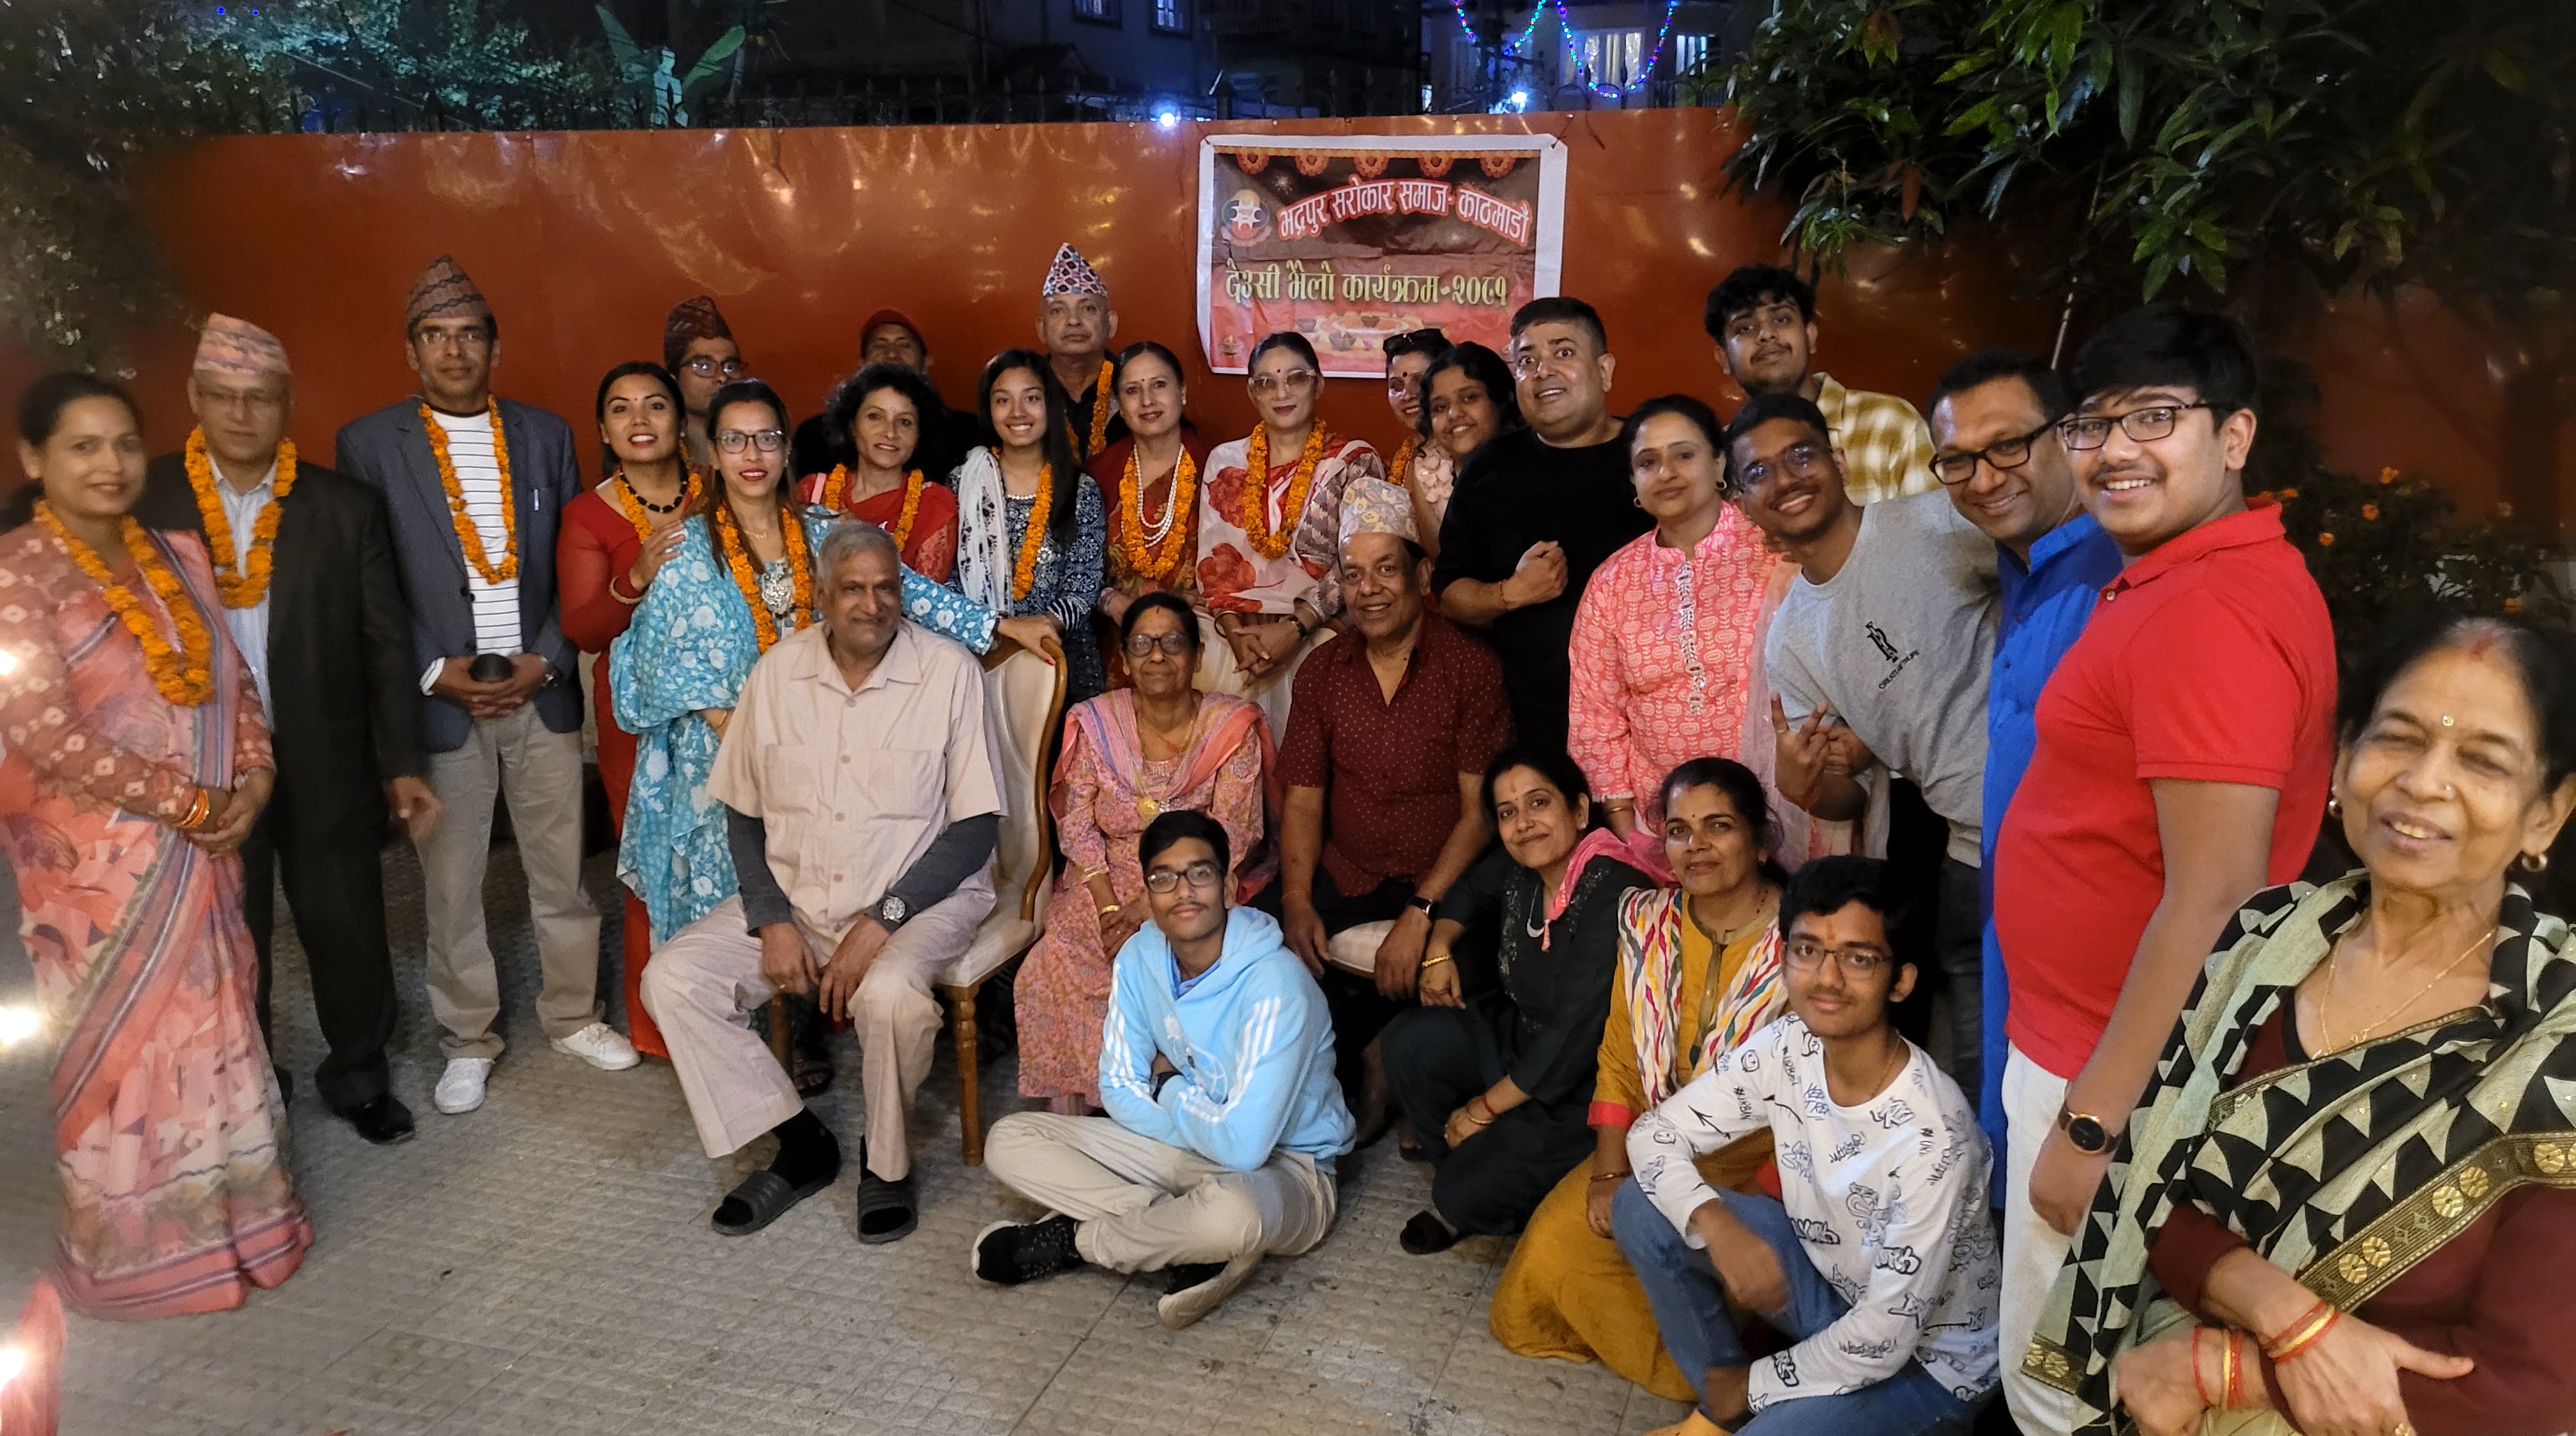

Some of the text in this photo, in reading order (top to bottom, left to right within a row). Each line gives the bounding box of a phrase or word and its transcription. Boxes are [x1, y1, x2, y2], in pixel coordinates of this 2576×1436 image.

[1280, 194, 1328, 237] भद्रपुर
[1331, 176, 1395, 219] सरोकार
[1225, 258, 1281, 304] देउसी
[1285, 259, 1337, 301] भैलो
